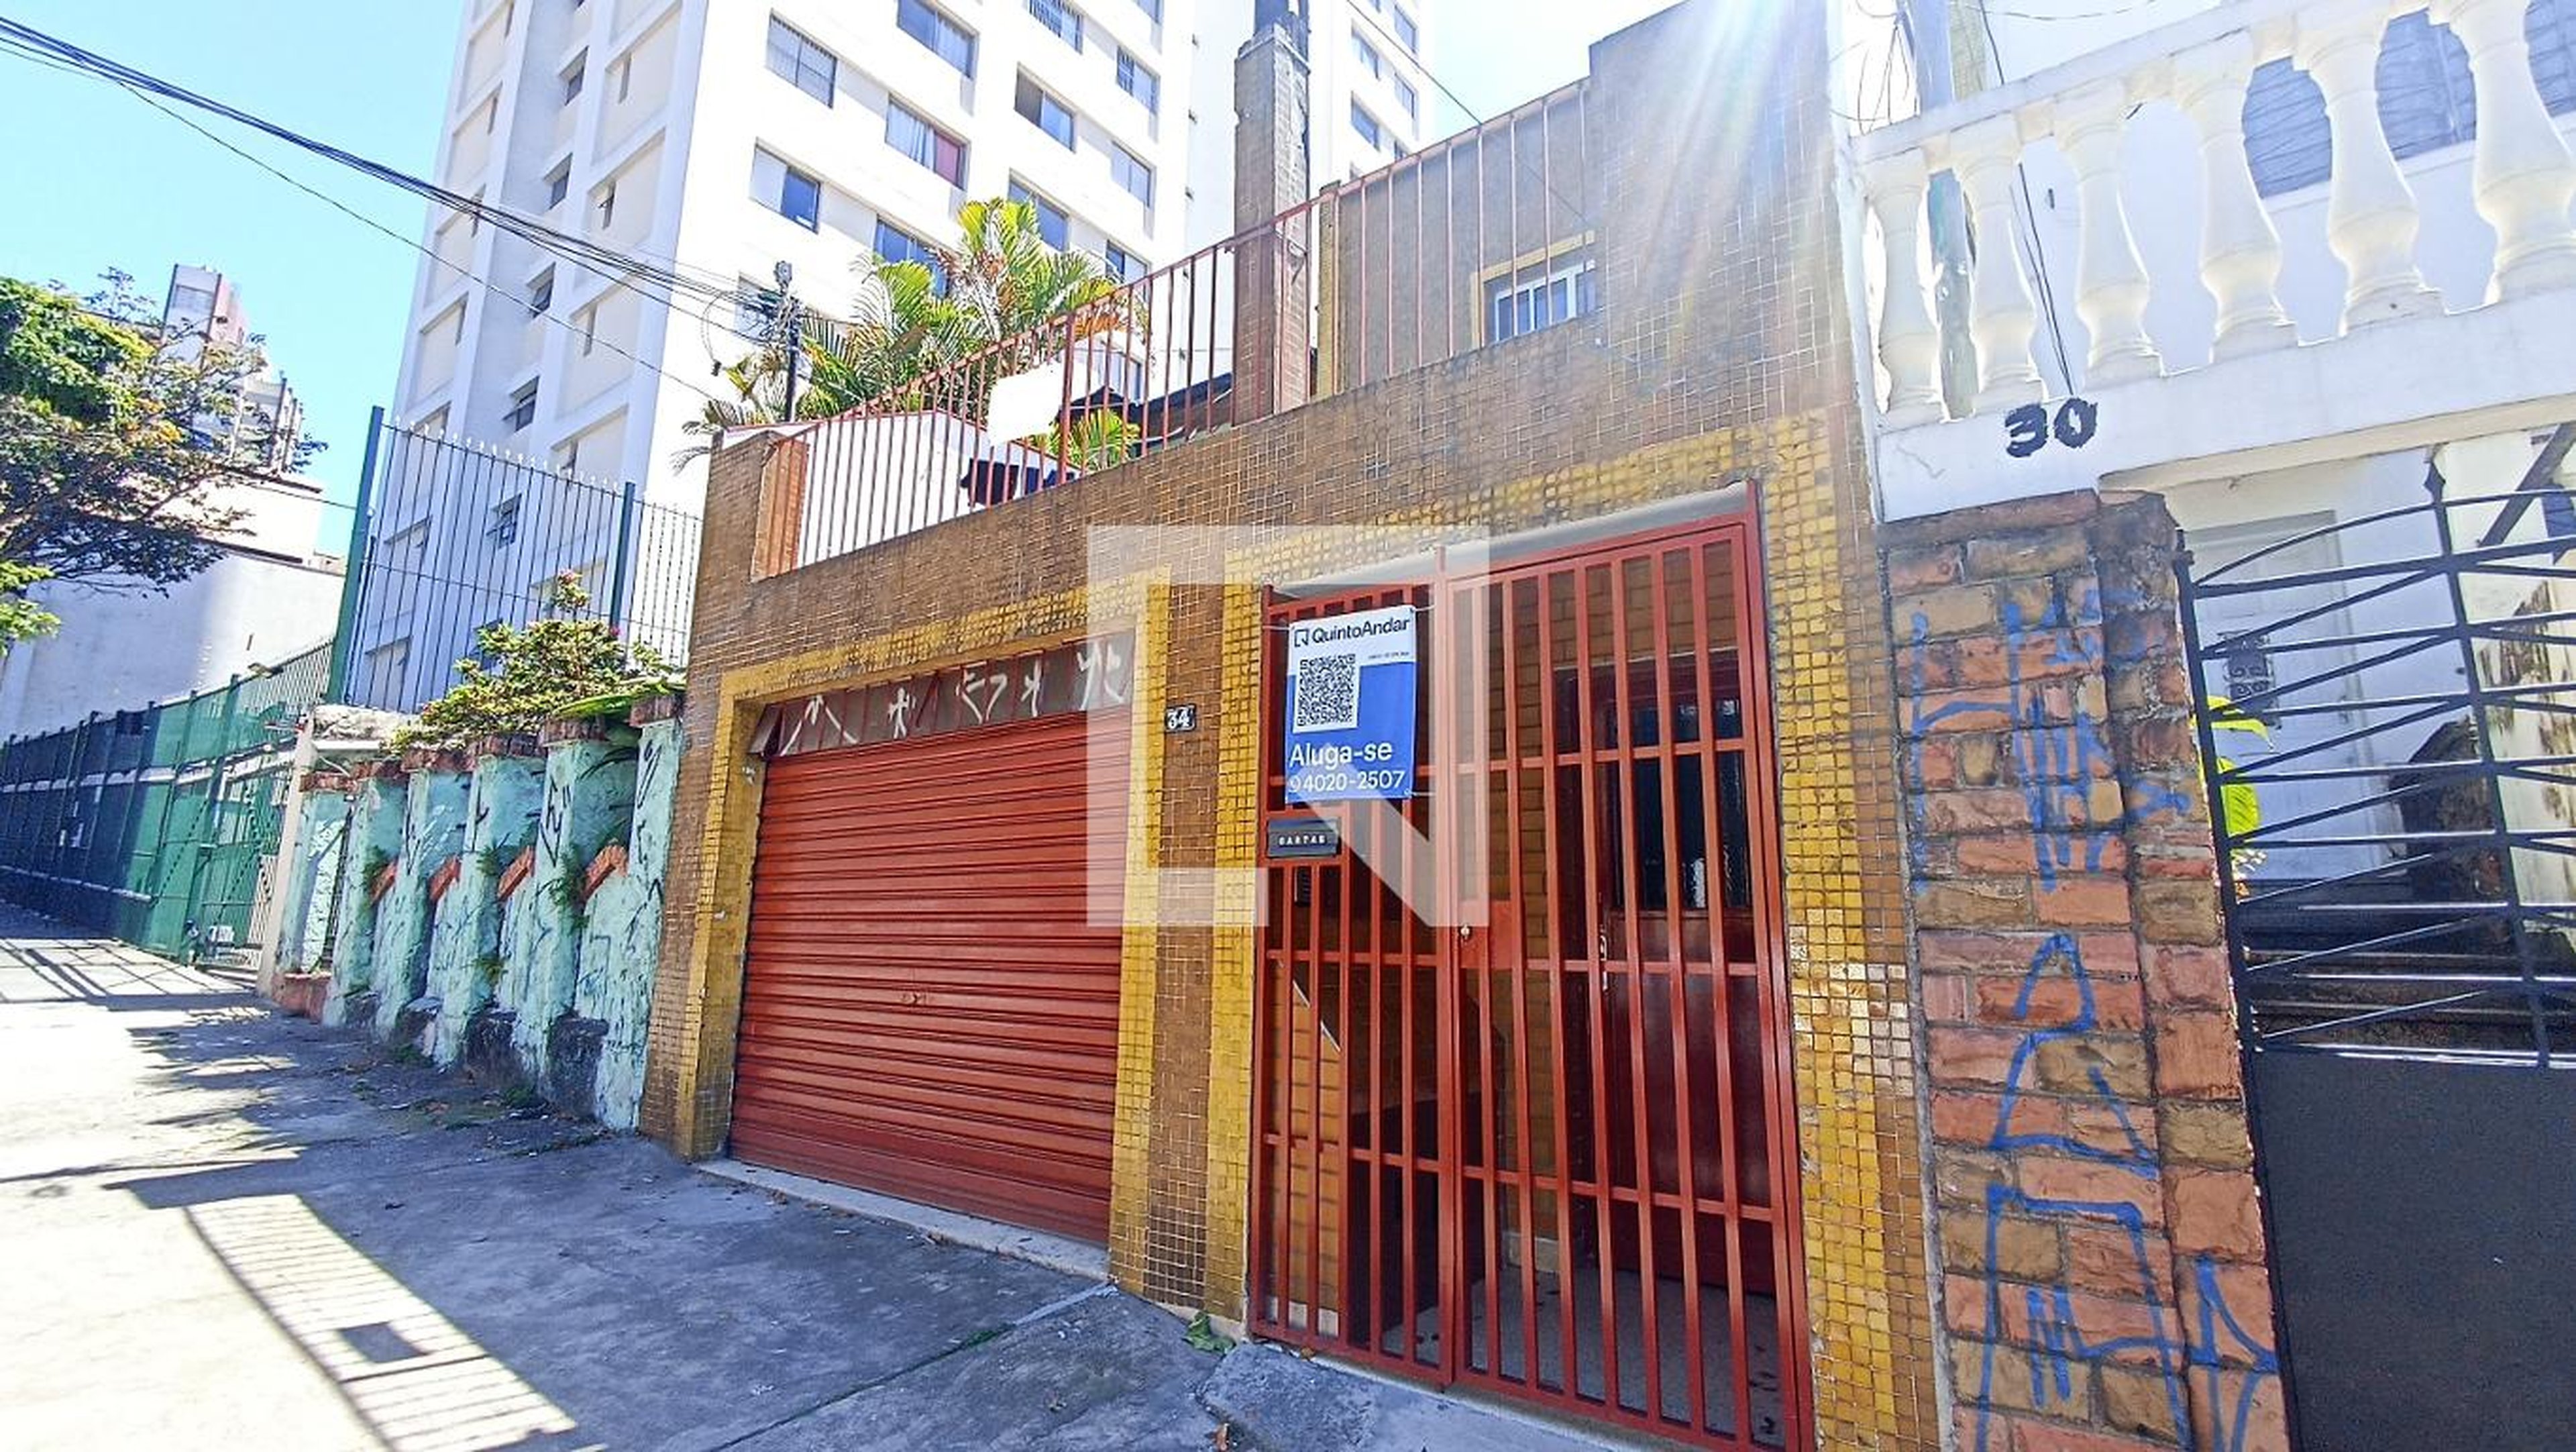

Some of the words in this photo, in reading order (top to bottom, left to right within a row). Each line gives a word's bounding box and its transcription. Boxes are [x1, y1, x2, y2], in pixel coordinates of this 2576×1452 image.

[2004, 397, 2098, 458] 30
[1311, 617, 1411, 643] QuintoAndar
[1289, 741, 1393, 770] Aluga-se
[1288, 770, 1405, 793] 94020-2507
